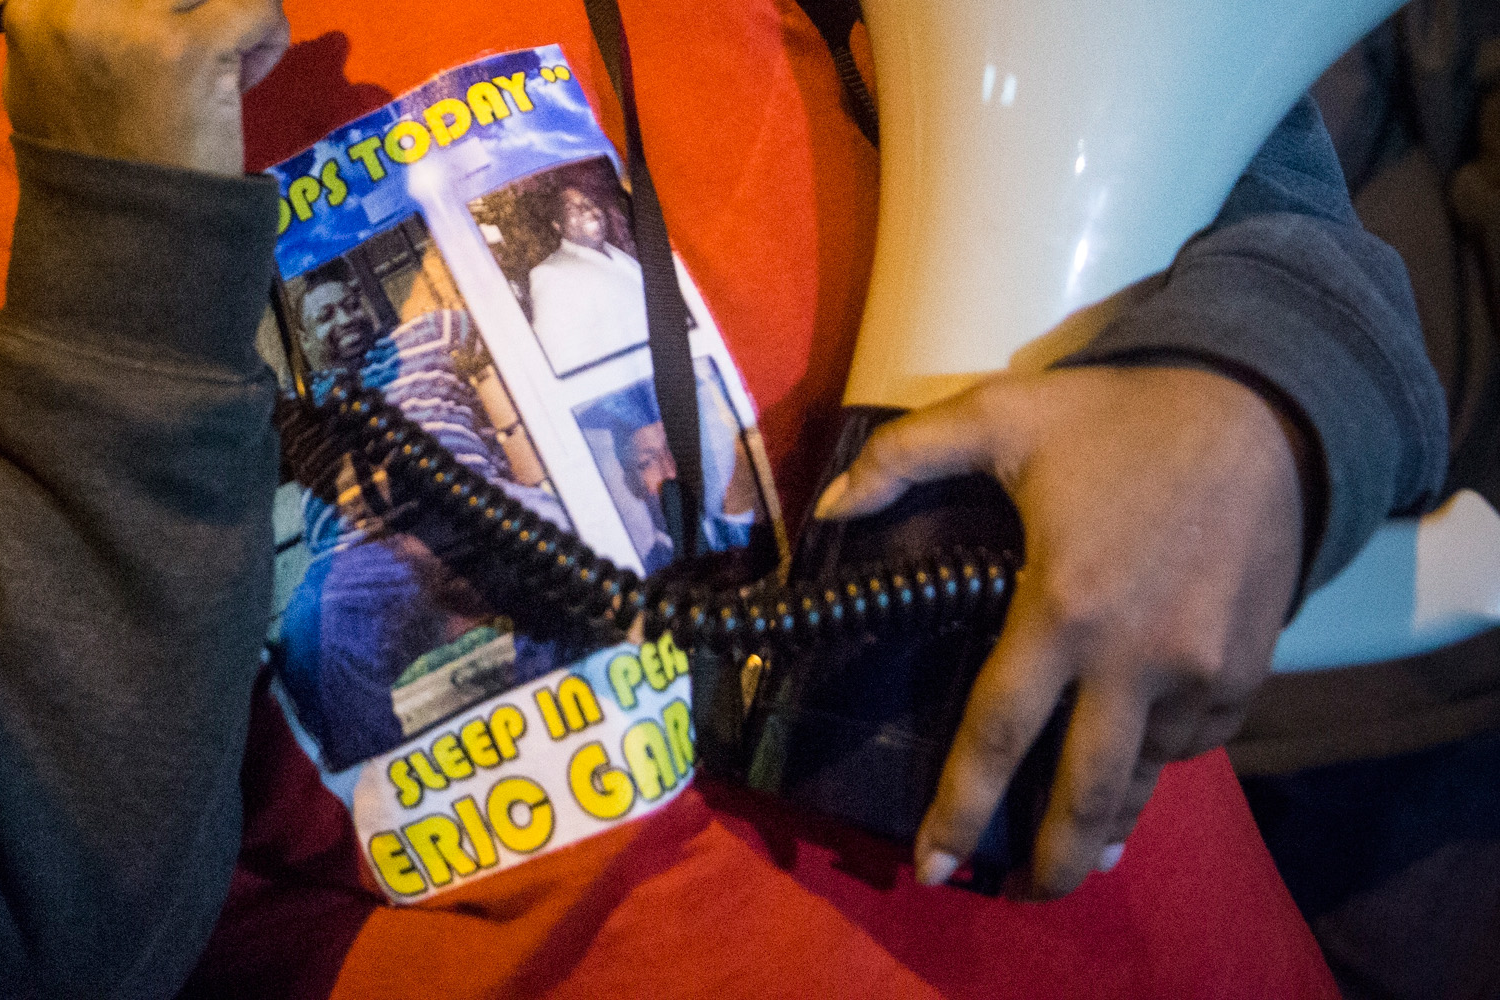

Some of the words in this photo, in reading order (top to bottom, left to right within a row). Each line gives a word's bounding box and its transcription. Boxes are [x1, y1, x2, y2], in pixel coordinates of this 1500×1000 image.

[387, 702, 528, 811] SLEEP
[532, 672, 606, 742] IN
[367, 774, 556, 898] ERIC
